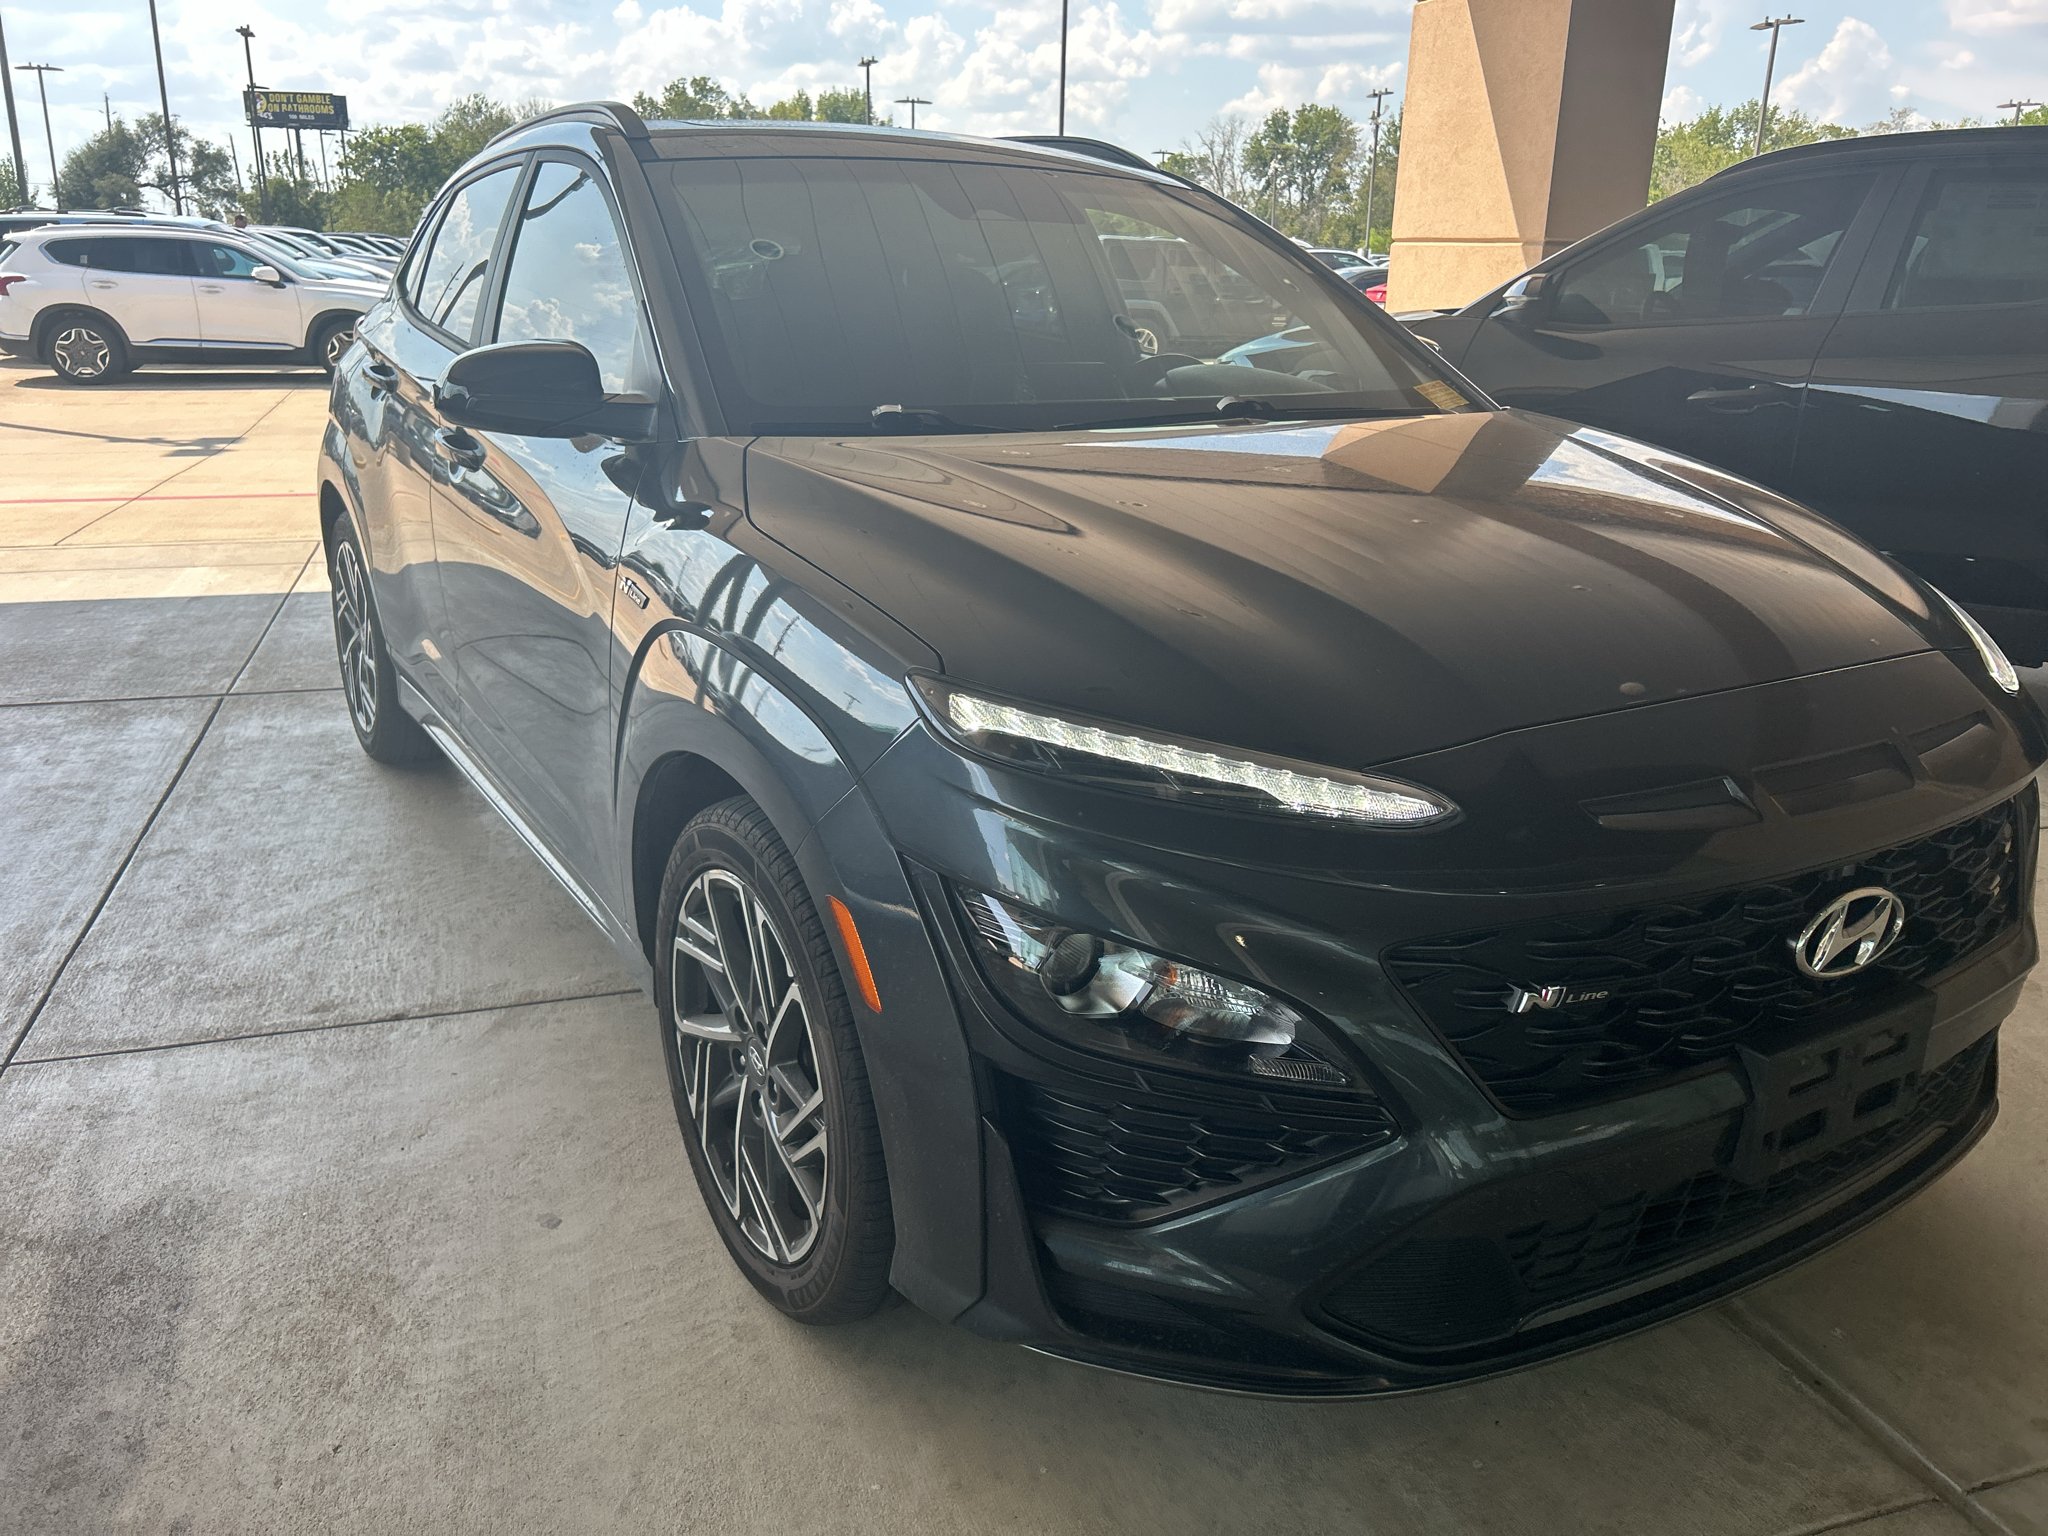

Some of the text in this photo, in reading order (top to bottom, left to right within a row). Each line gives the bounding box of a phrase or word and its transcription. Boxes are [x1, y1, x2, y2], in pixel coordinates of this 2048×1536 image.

[269, 93, 331, 105] DON'T GAMBLE
[267, 103, 280, 113] ON
[1513, 985, 1566, 1013] N
